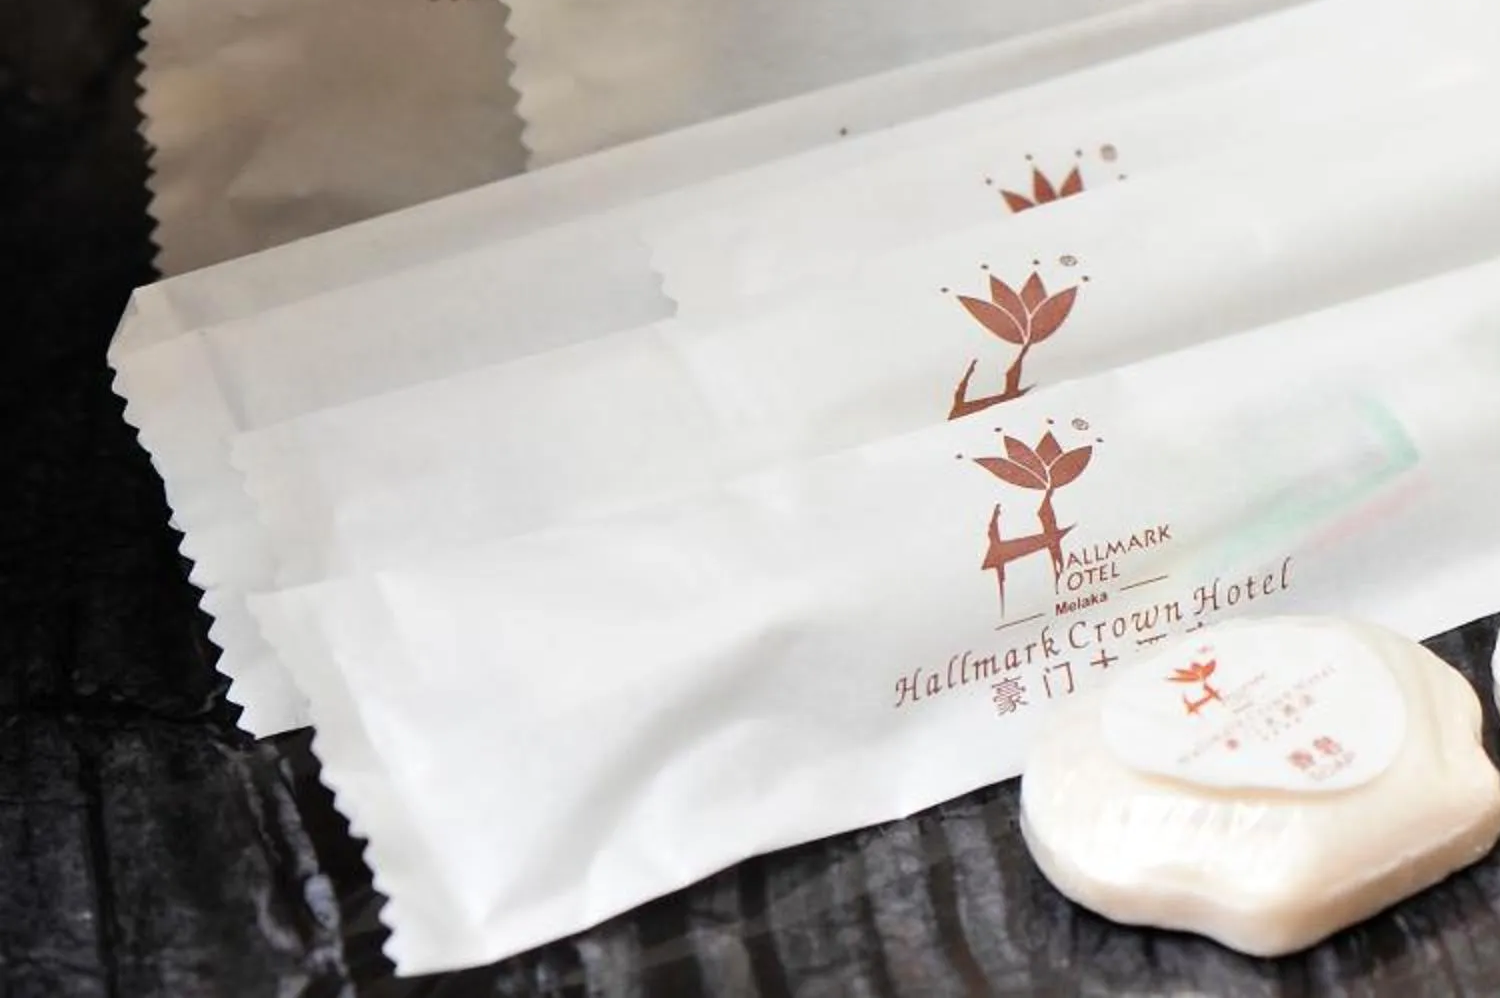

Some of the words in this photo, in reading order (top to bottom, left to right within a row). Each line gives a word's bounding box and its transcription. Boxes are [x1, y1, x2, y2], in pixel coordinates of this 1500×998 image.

[895, 626, 1061, 708] Hallmark
[1069, 600, 1183, 650] Crown
[1193, 556, 1293, 616] Hotel
[1055, 592, 1109, 616] Melaka
